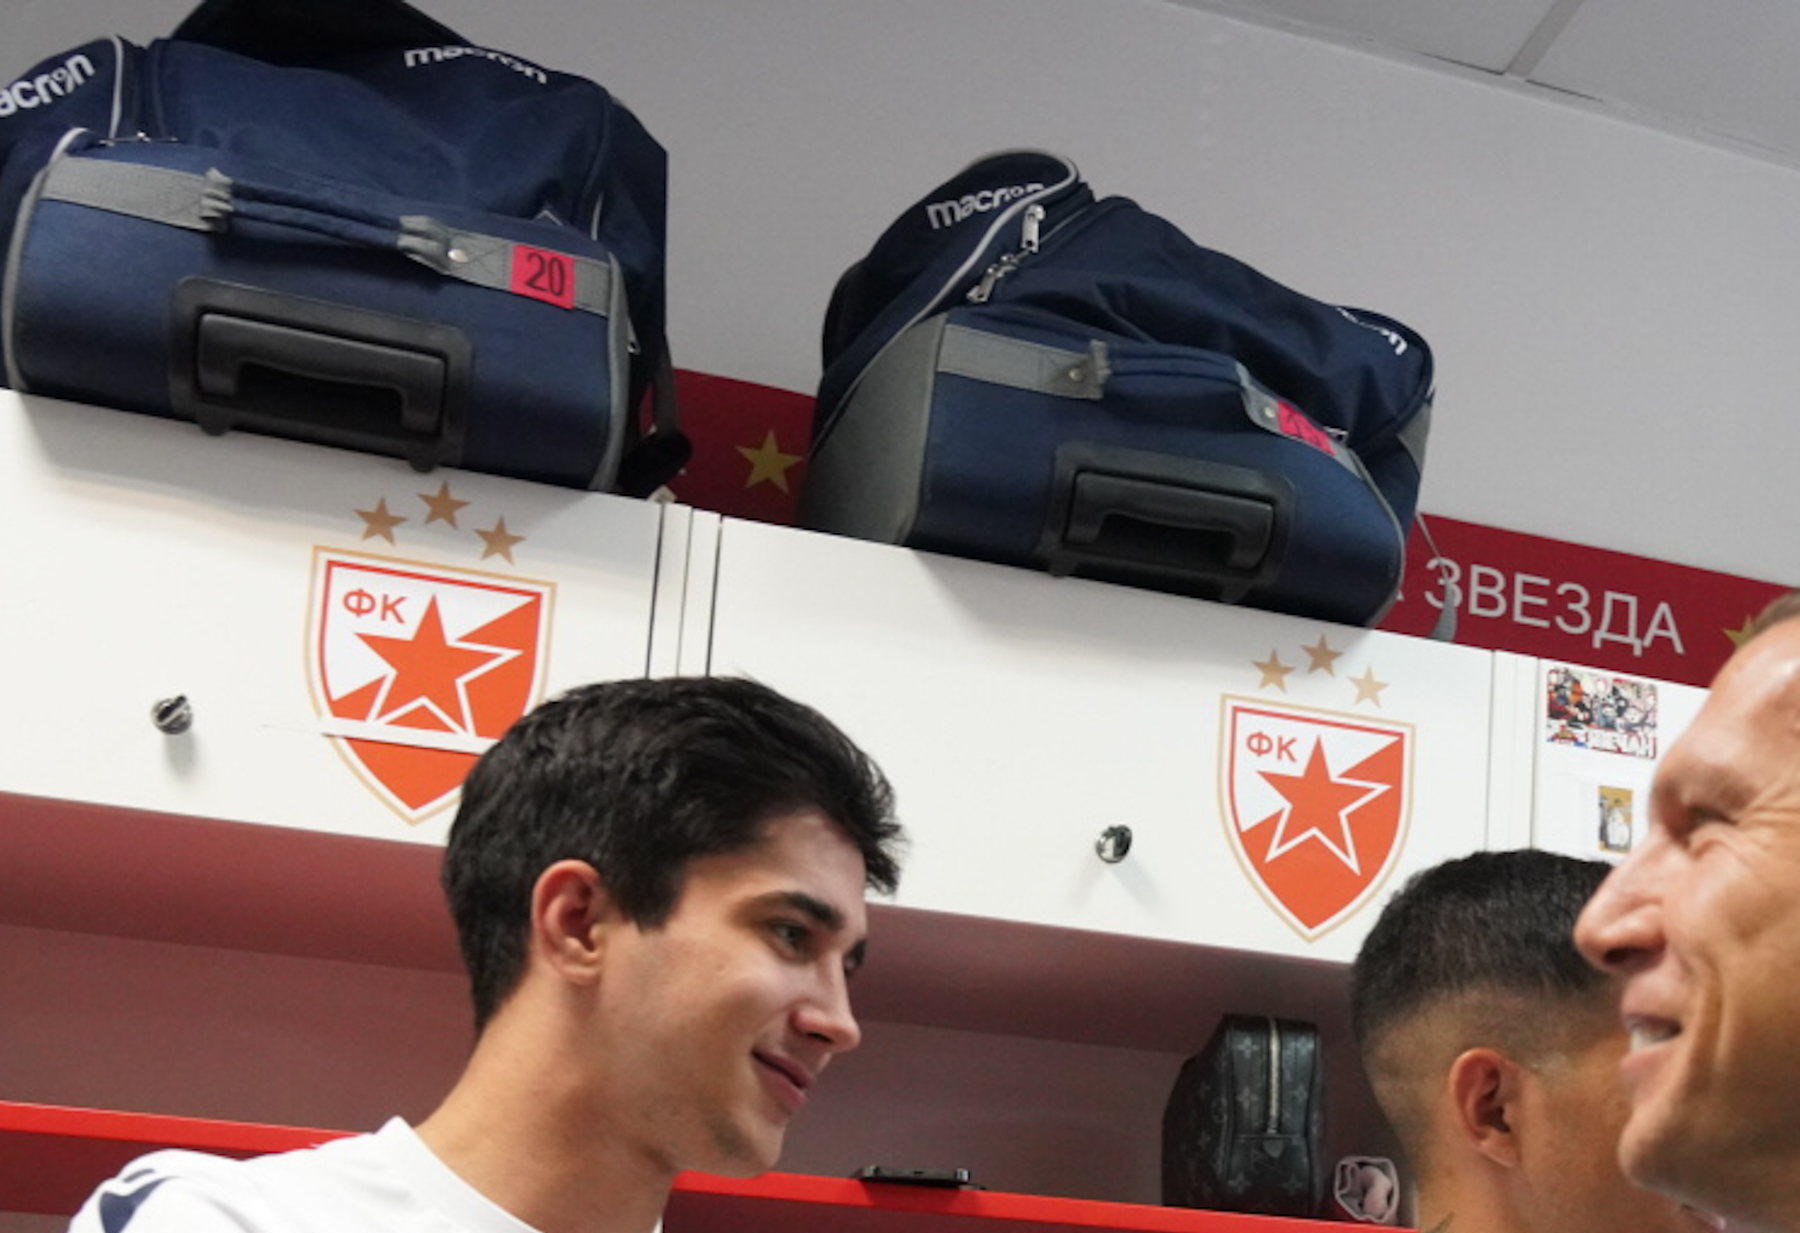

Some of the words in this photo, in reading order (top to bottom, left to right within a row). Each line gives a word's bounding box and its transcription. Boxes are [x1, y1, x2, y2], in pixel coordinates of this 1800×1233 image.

[526, 252, 566, 296] 20
[342, 587, 408, 624] ФК
[1424, 556, 1686, 656] ЗВЕЗДА
[1247, 730, 1298, 764] ФК
